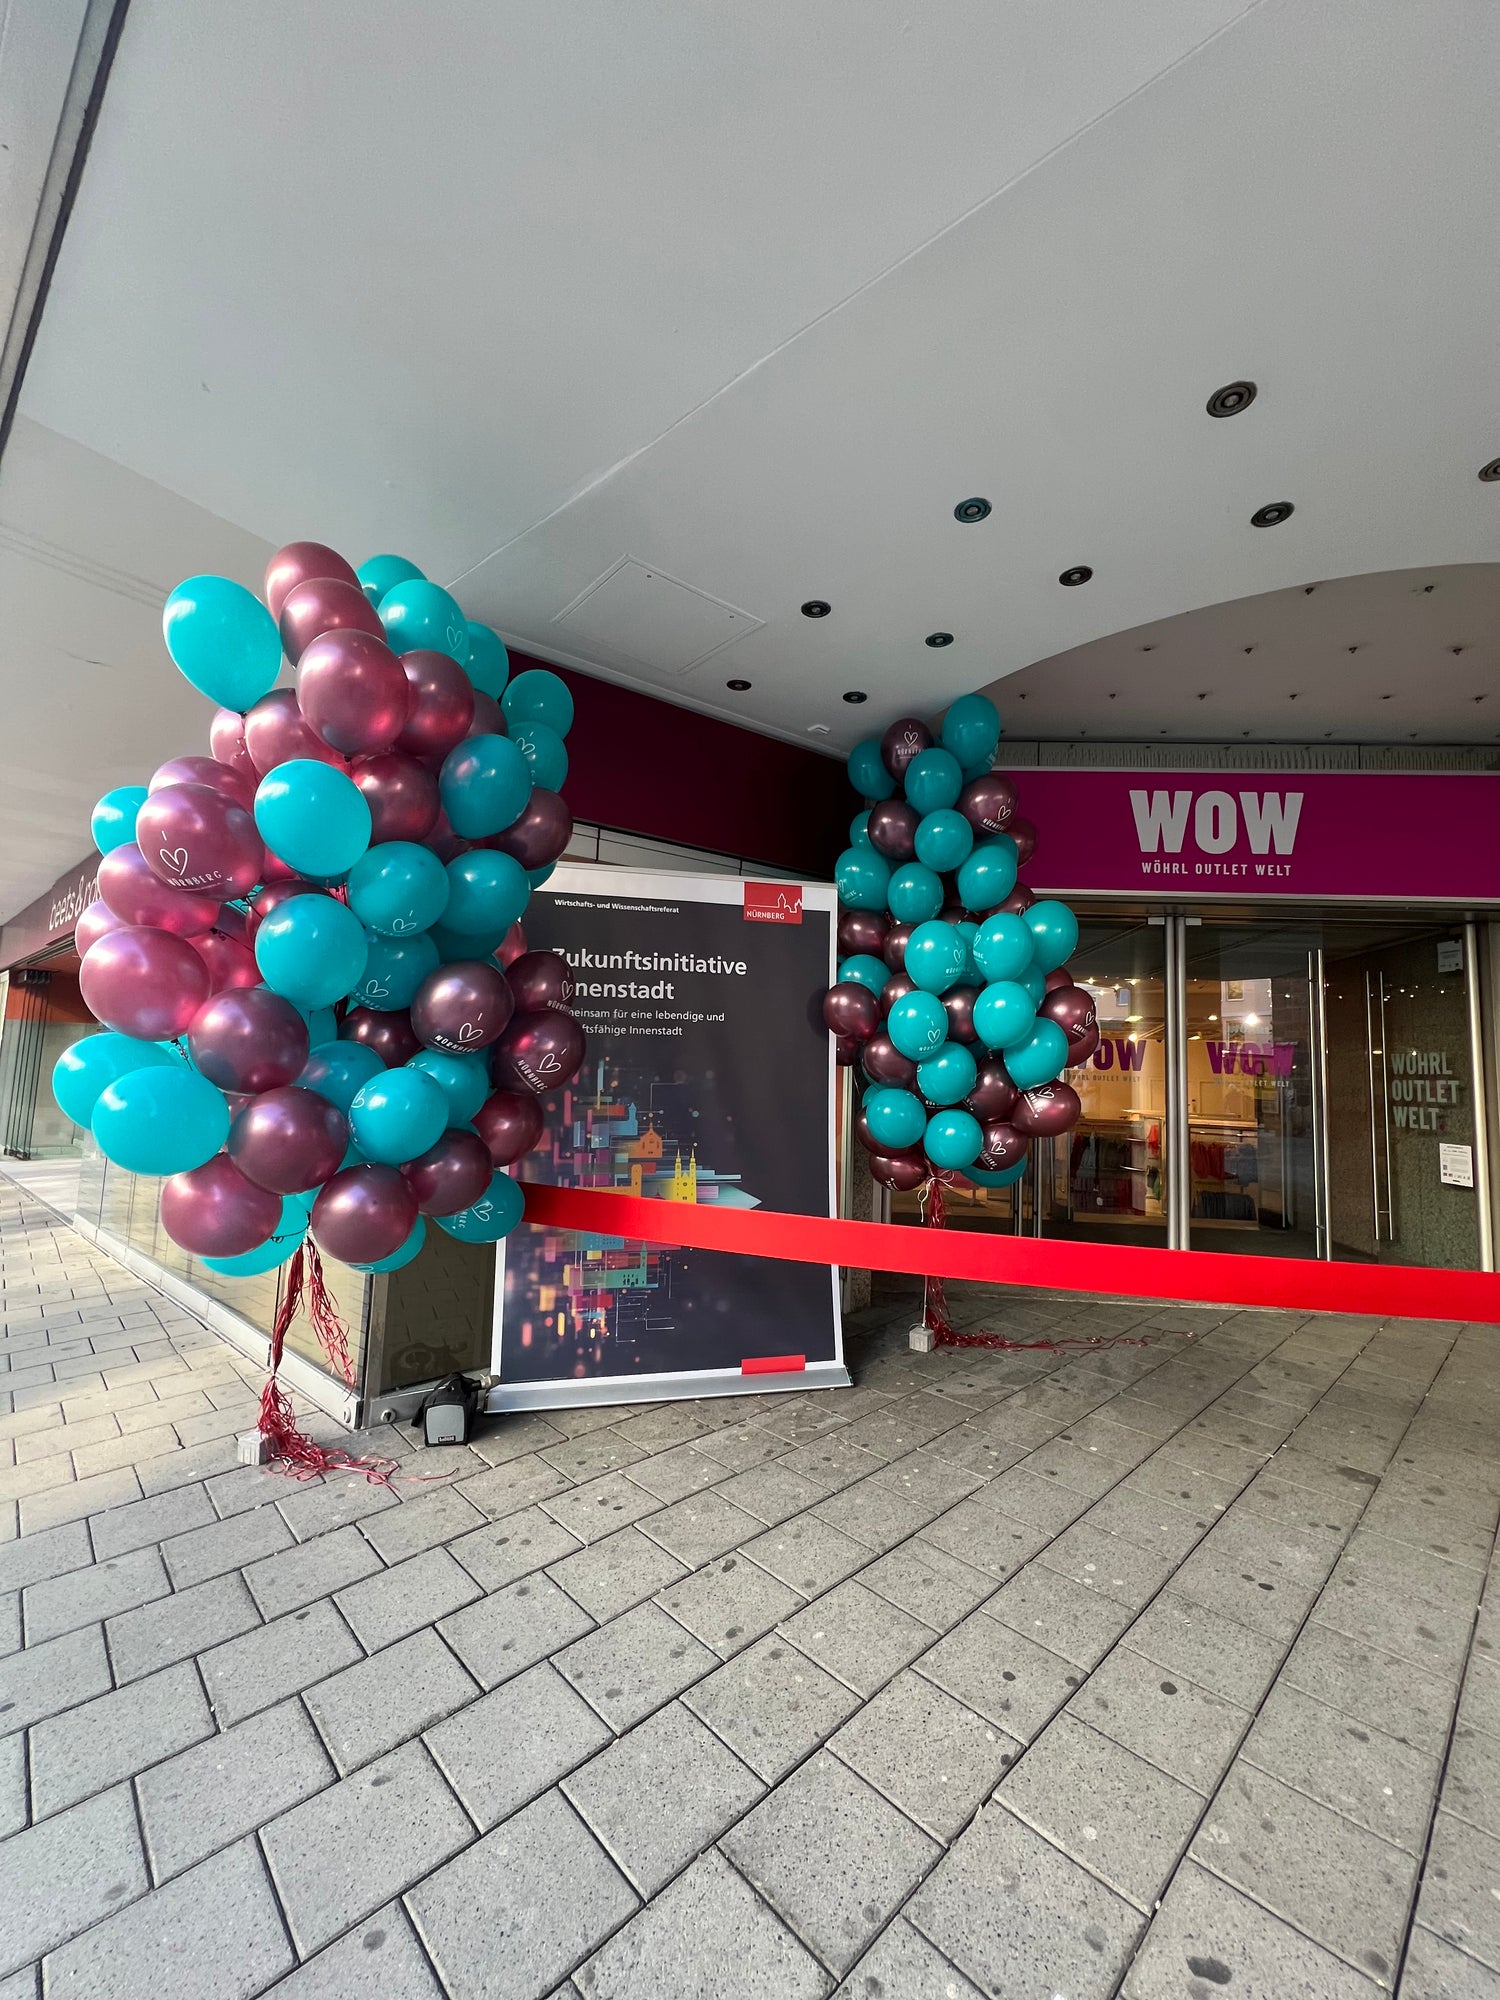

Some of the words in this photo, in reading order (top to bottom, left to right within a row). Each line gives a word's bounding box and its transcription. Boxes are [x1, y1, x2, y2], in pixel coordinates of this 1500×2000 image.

[1129, 790, 1305, 855] WOW
[1141, 860, 1189, 875] WÖHRL
[1195, 863, 1248, 876] OUTLET
[1255, 864, 1292, 877] WELT
[554, 899, 596, 908] Wirtschafts-
[596, 902, 611, 910] und
[611, 902, 680, 914] Wissenschaftsreferat
[746, 909, 785, 920] NÜRNBERG
[574, 980, 675, 1000] nenstadt
[568, 1007, 610, 1019] einsam
[613, 1009, 629, 1019] für
[631, 1009, 653, 1020] eine
[654, 1009, 705, 1023] lebendige
[706, 1011, 725, 1022] und
[582, 1024, 628, 1037] tsfähige
[629, 1025, 683, 1036] Innenstadt
[1077, 1038, 1147, 1072] OW
[1205, 1041, 1295, 1076] WOW
[1391, 1079, 1460, 1104] OUTLET
